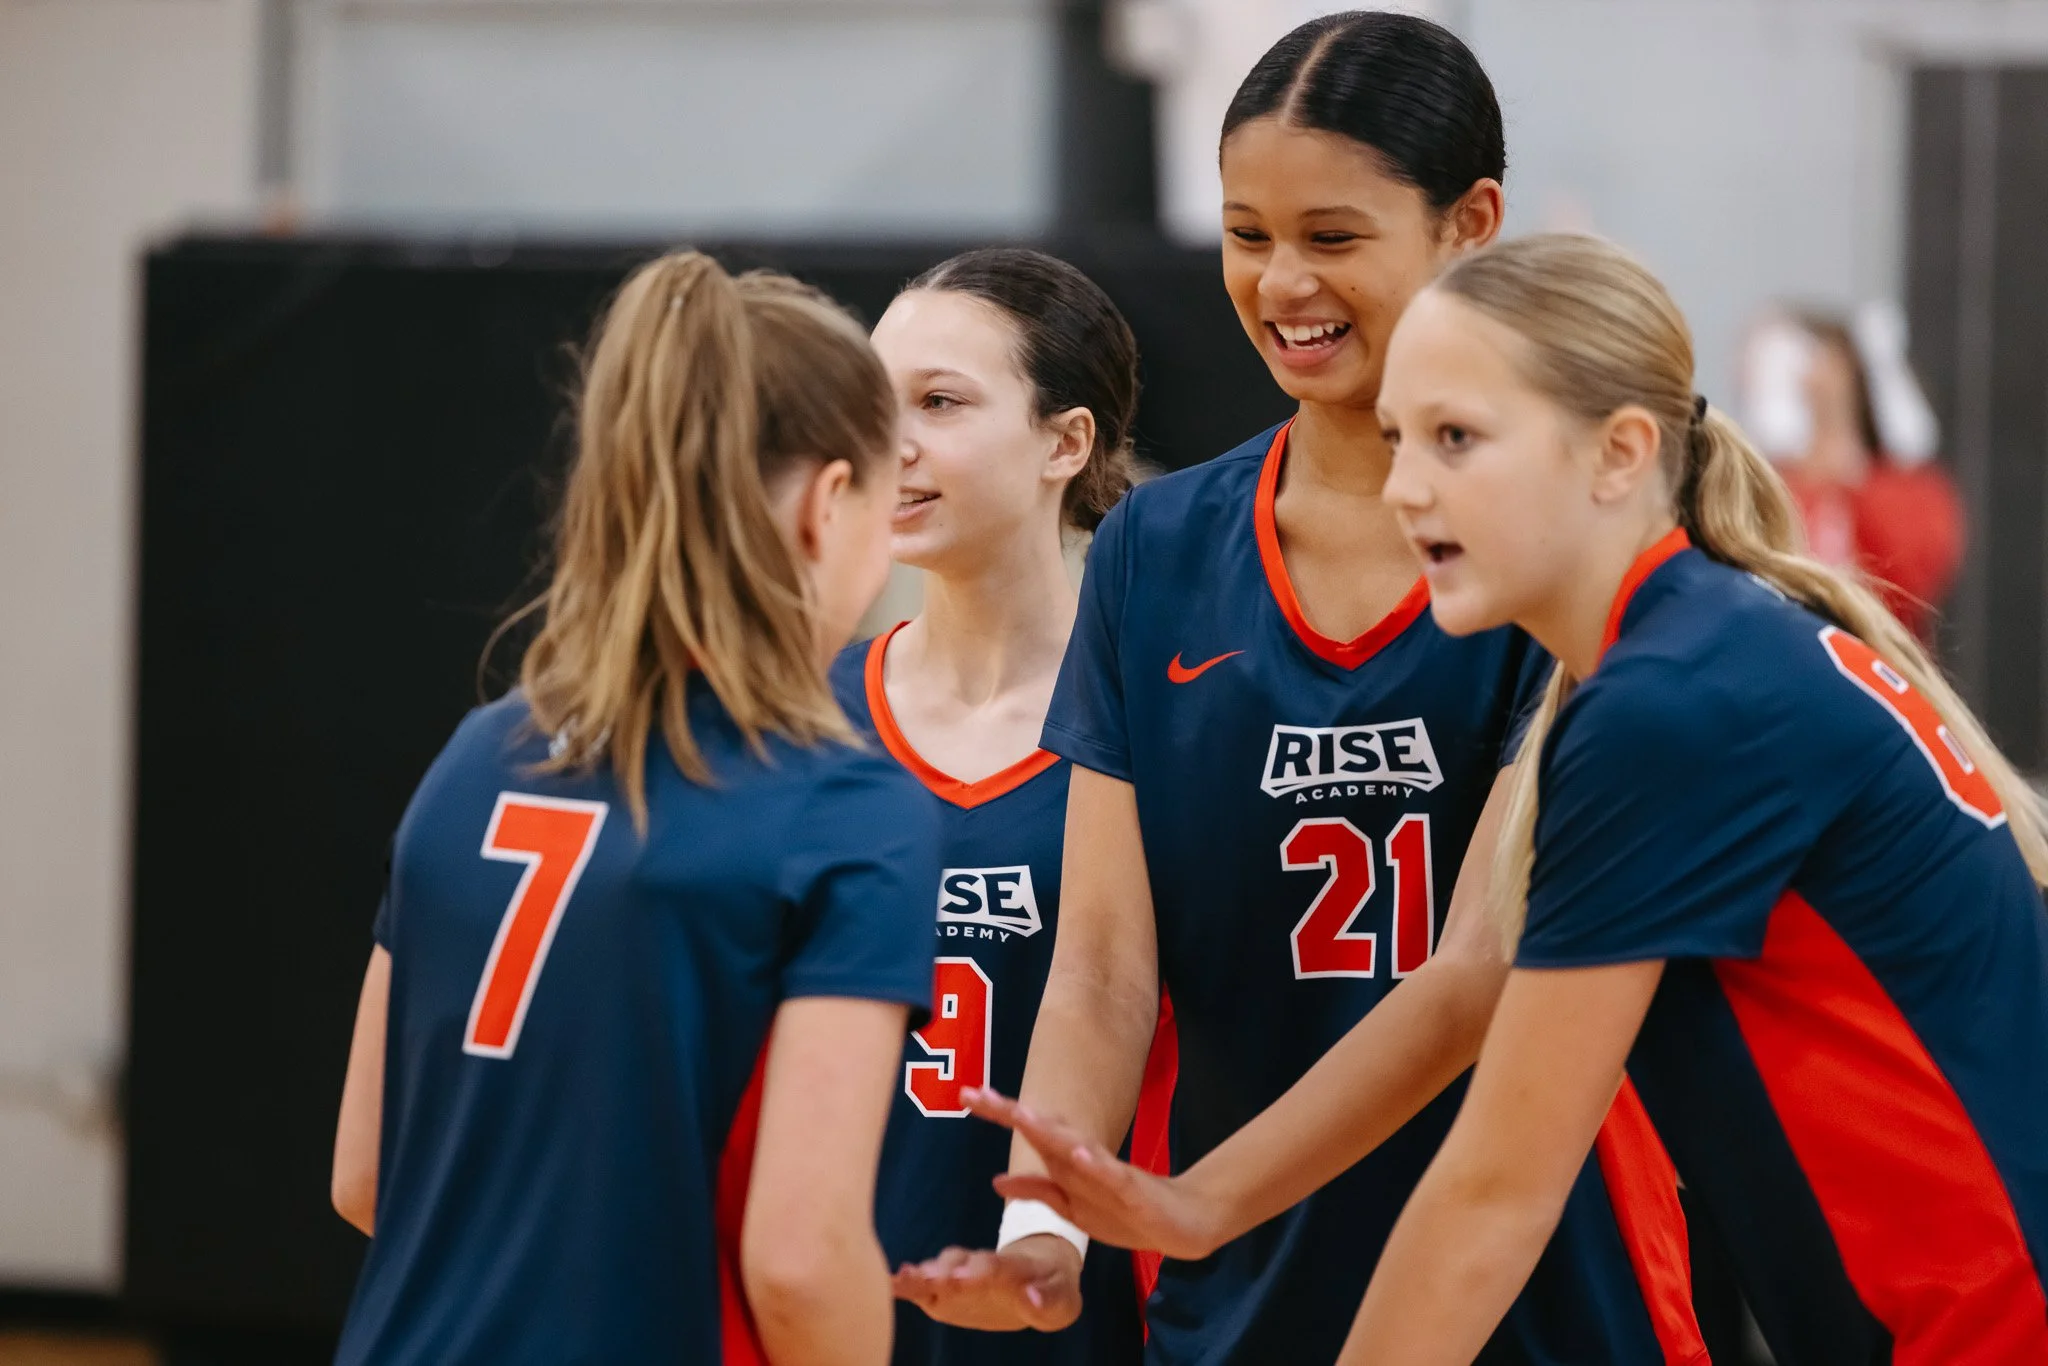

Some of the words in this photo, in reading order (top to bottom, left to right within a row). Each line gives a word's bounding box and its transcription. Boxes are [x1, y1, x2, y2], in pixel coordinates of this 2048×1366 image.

[1270, 725, 1432, 780] RISE
[1295, 784, 1414, 805] ACADEMY
[940, 872, 1031, 920] SE
[1279, 812, 1435, 980] 21
[462, 790, 610, 1060] 7
[935, 925, 1010, 943] DEMY
[904, 956, 993, 1118] 9
